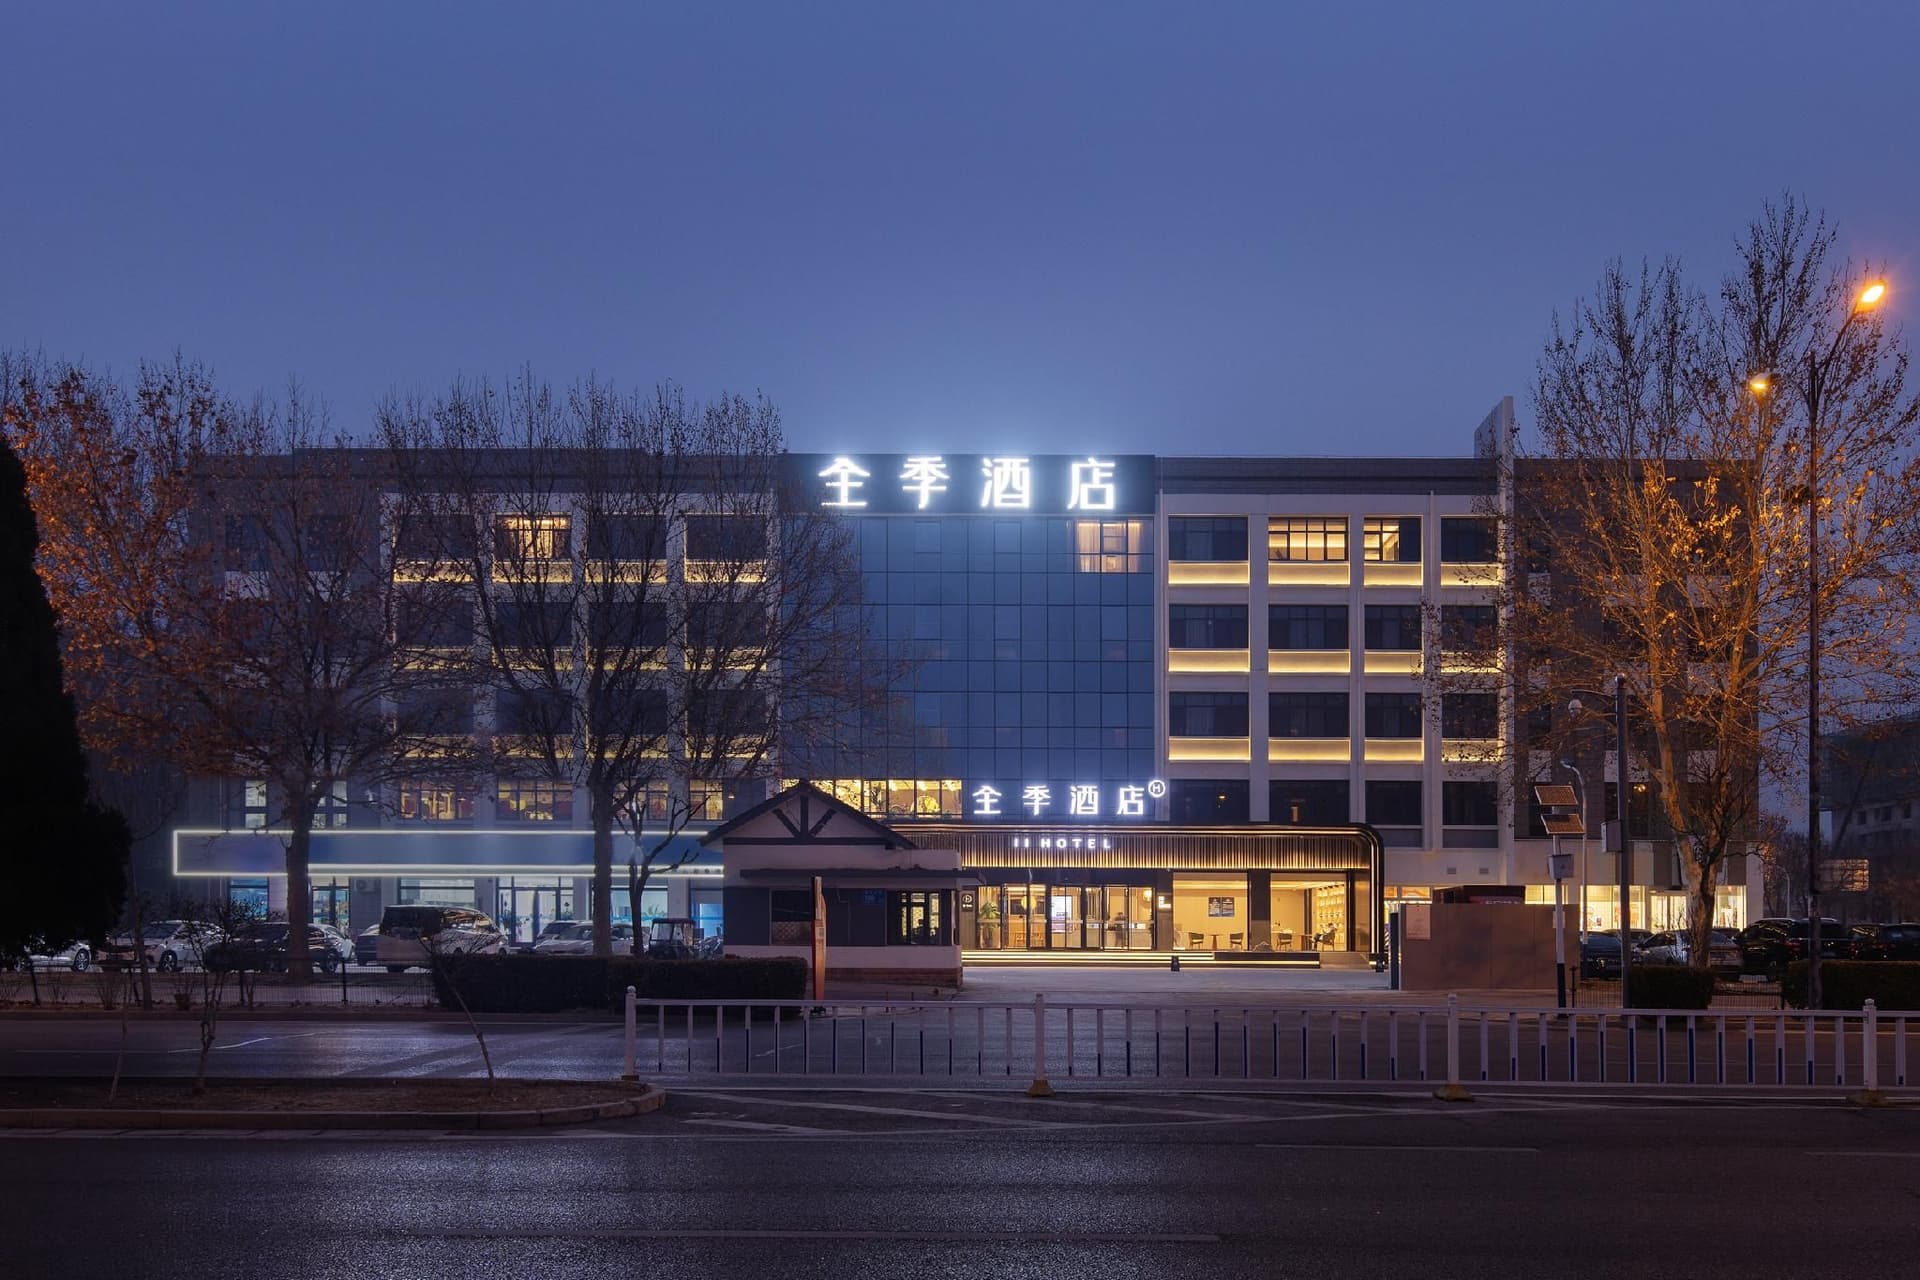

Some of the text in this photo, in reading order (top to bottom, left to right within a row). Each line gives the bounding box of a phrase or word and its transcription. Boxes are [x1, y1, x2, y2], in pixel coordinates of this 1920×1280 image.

[818, 455, 1117, 510] 全季酒店
[972, 784, 1145, 816] 全季酒店
[1040, 838, 1111, 850] HOTEL
